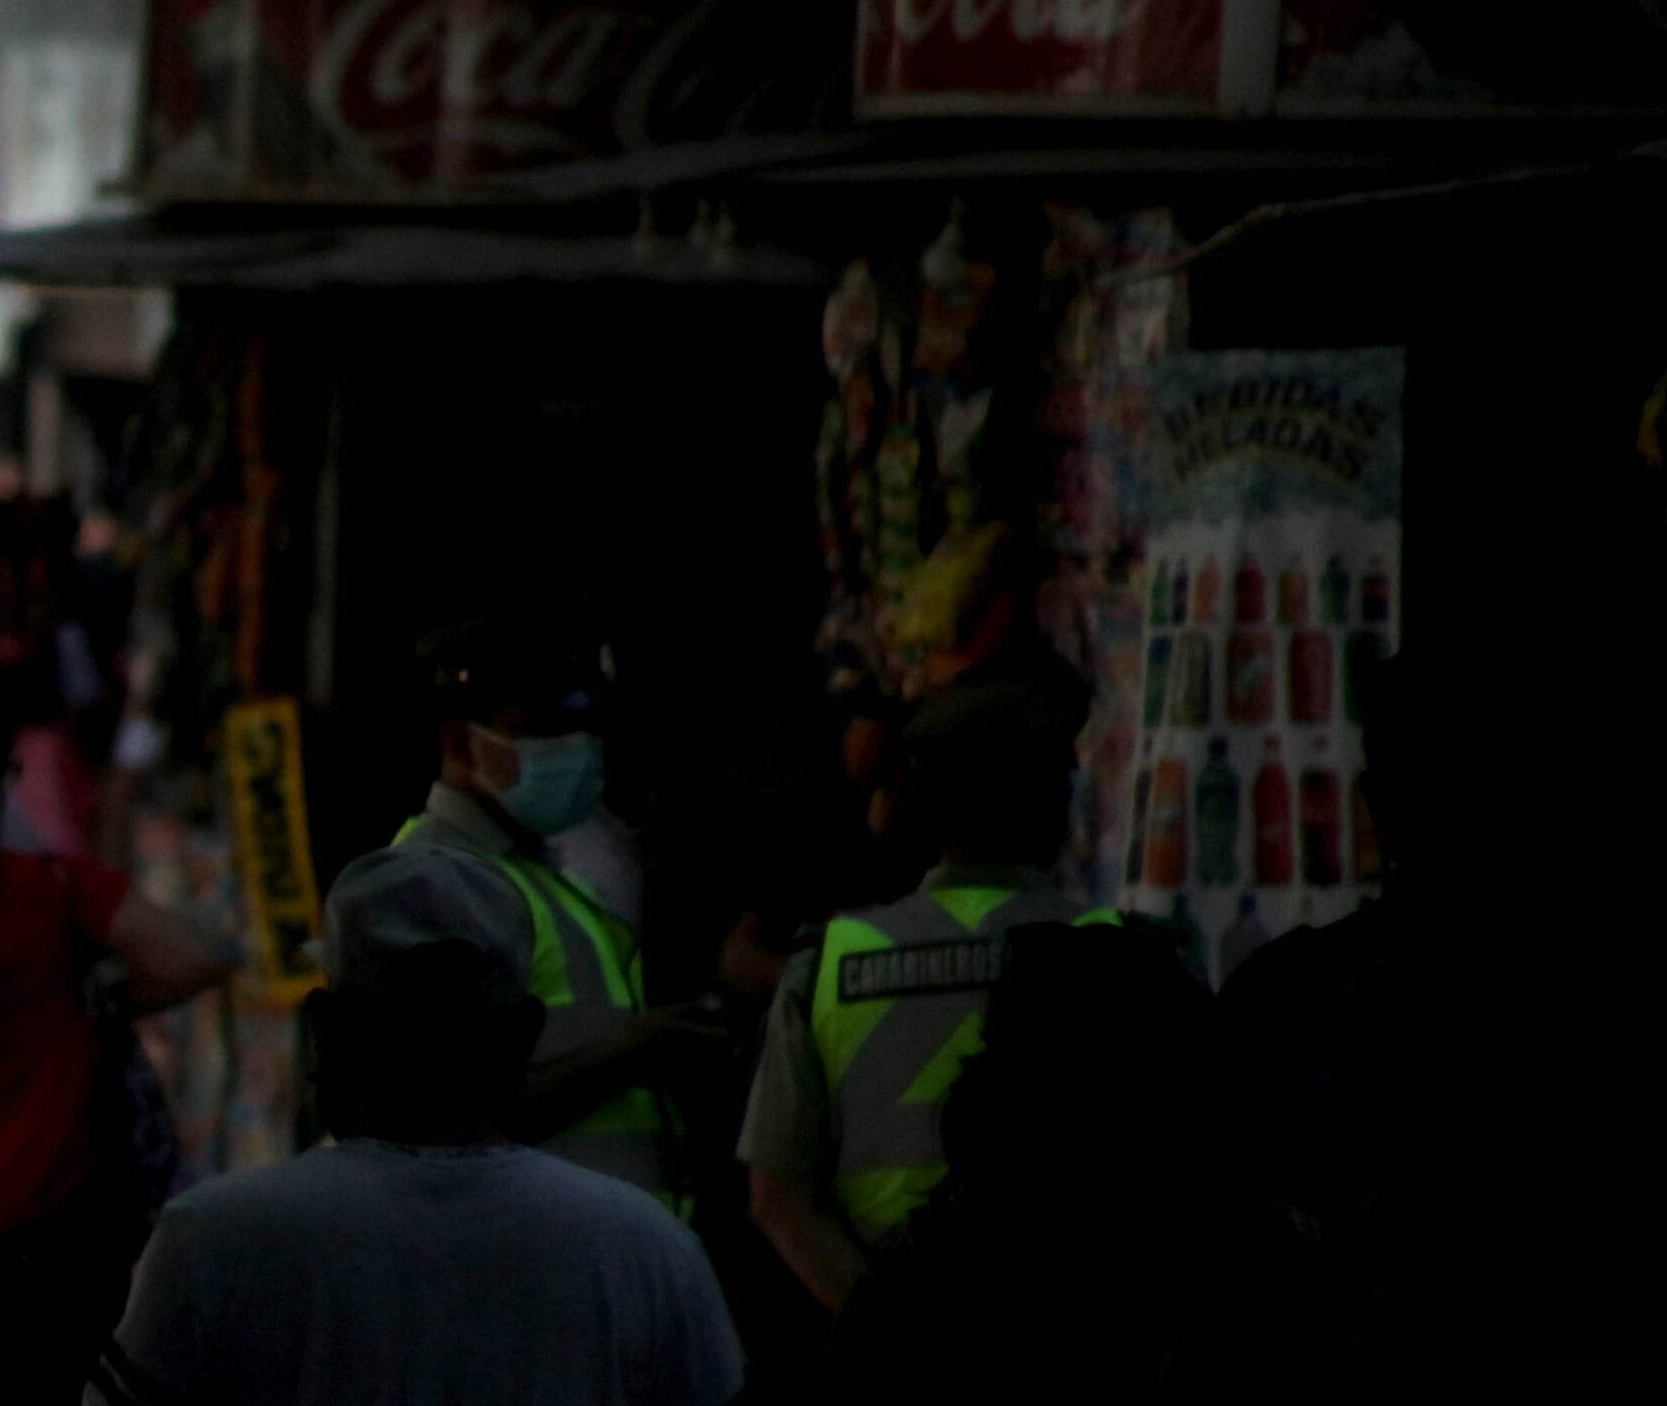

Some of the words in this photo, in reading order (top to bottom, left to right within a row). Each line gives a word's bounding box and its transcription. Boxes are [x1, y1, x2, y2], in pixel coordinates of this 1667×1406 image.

[1165, 378, 1384, 441] BEBIDAS
[1173, 418, 1365, 480] HELADAS
[845, 943, 1002, 995] CARABINEROS
